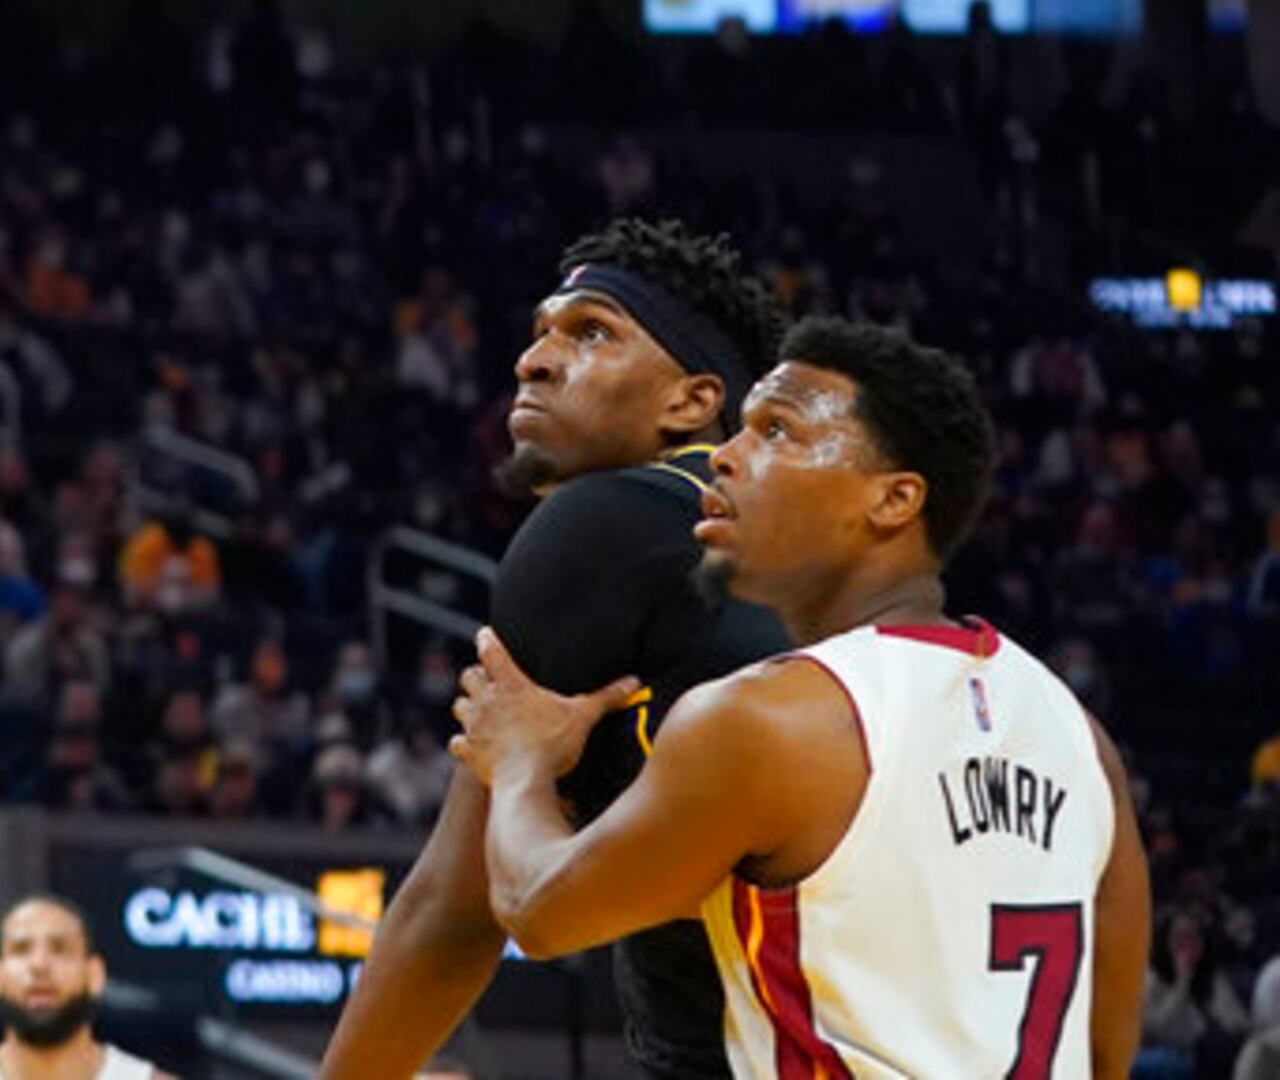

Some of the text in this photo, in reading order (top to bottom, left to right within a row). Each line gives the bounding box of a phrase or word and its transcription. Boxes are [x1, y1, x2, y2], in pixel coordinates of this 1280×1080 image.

[939, 757, 1067, 851] LOWRY
[124, 887, 316, 951] CACHE
[225, 959, 343, 1003] CASINO
[987, 901, 1084, 1080] 7
